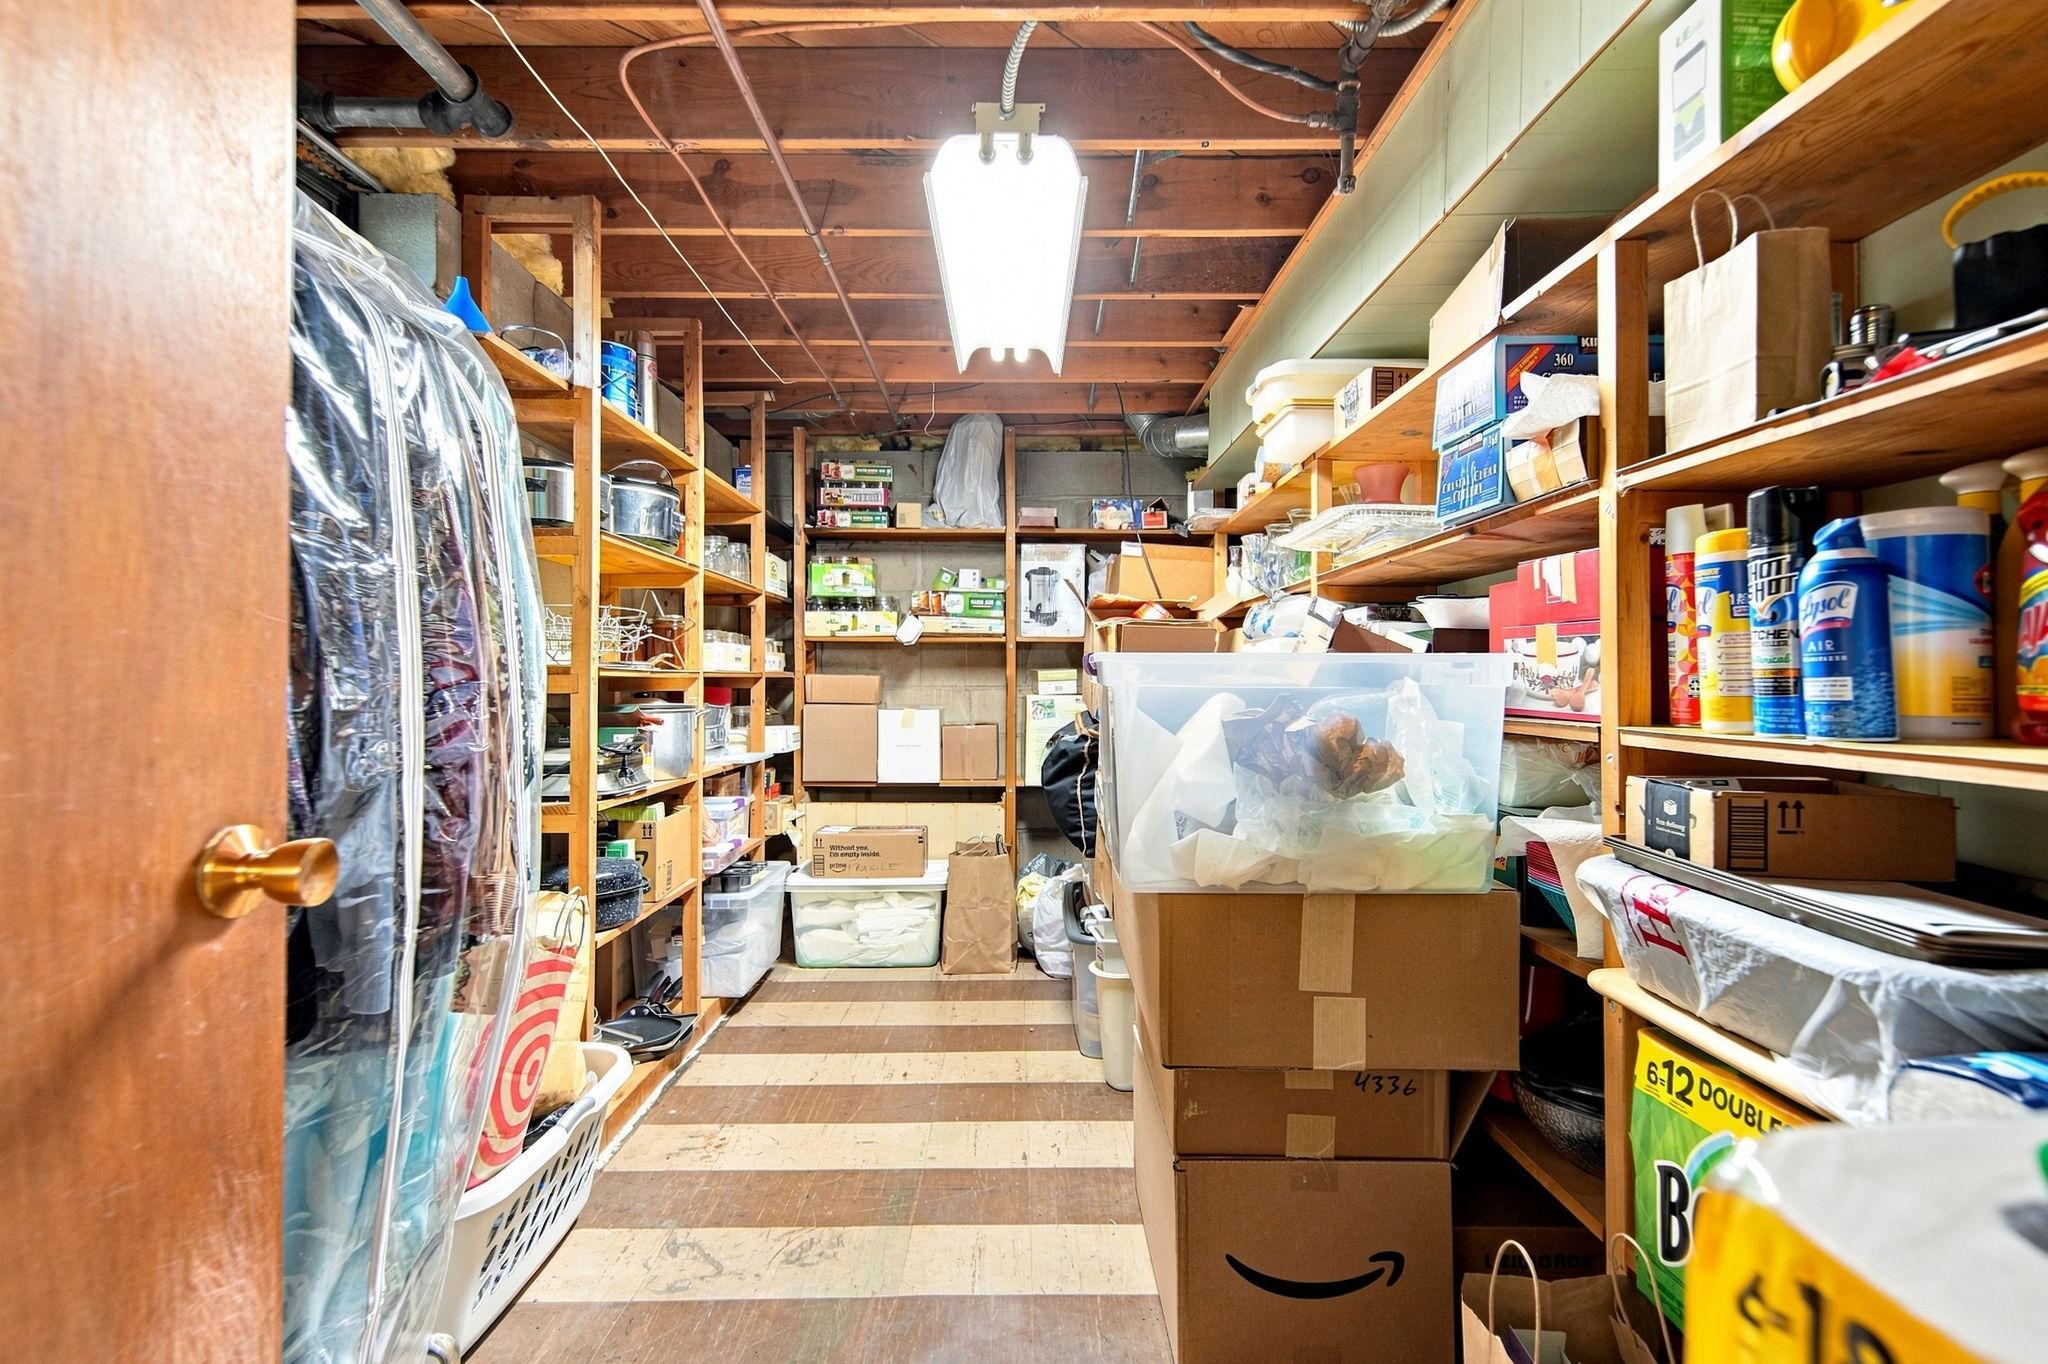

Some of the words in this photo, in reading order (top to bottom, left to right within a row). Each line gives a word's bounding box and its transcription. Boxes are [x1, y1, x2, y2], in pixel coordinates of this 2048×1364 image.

[1553, 353, 1574, 366] 360
[1800, 588, 1851, 622] Lysol
[1752, 628, 1800, 640] TCHEN
[1807, 639, 1835, 652] AIR
[1354, 1072, 1417, 1097] 4336
[1646, 1059, 1694, 1107] 6=12
